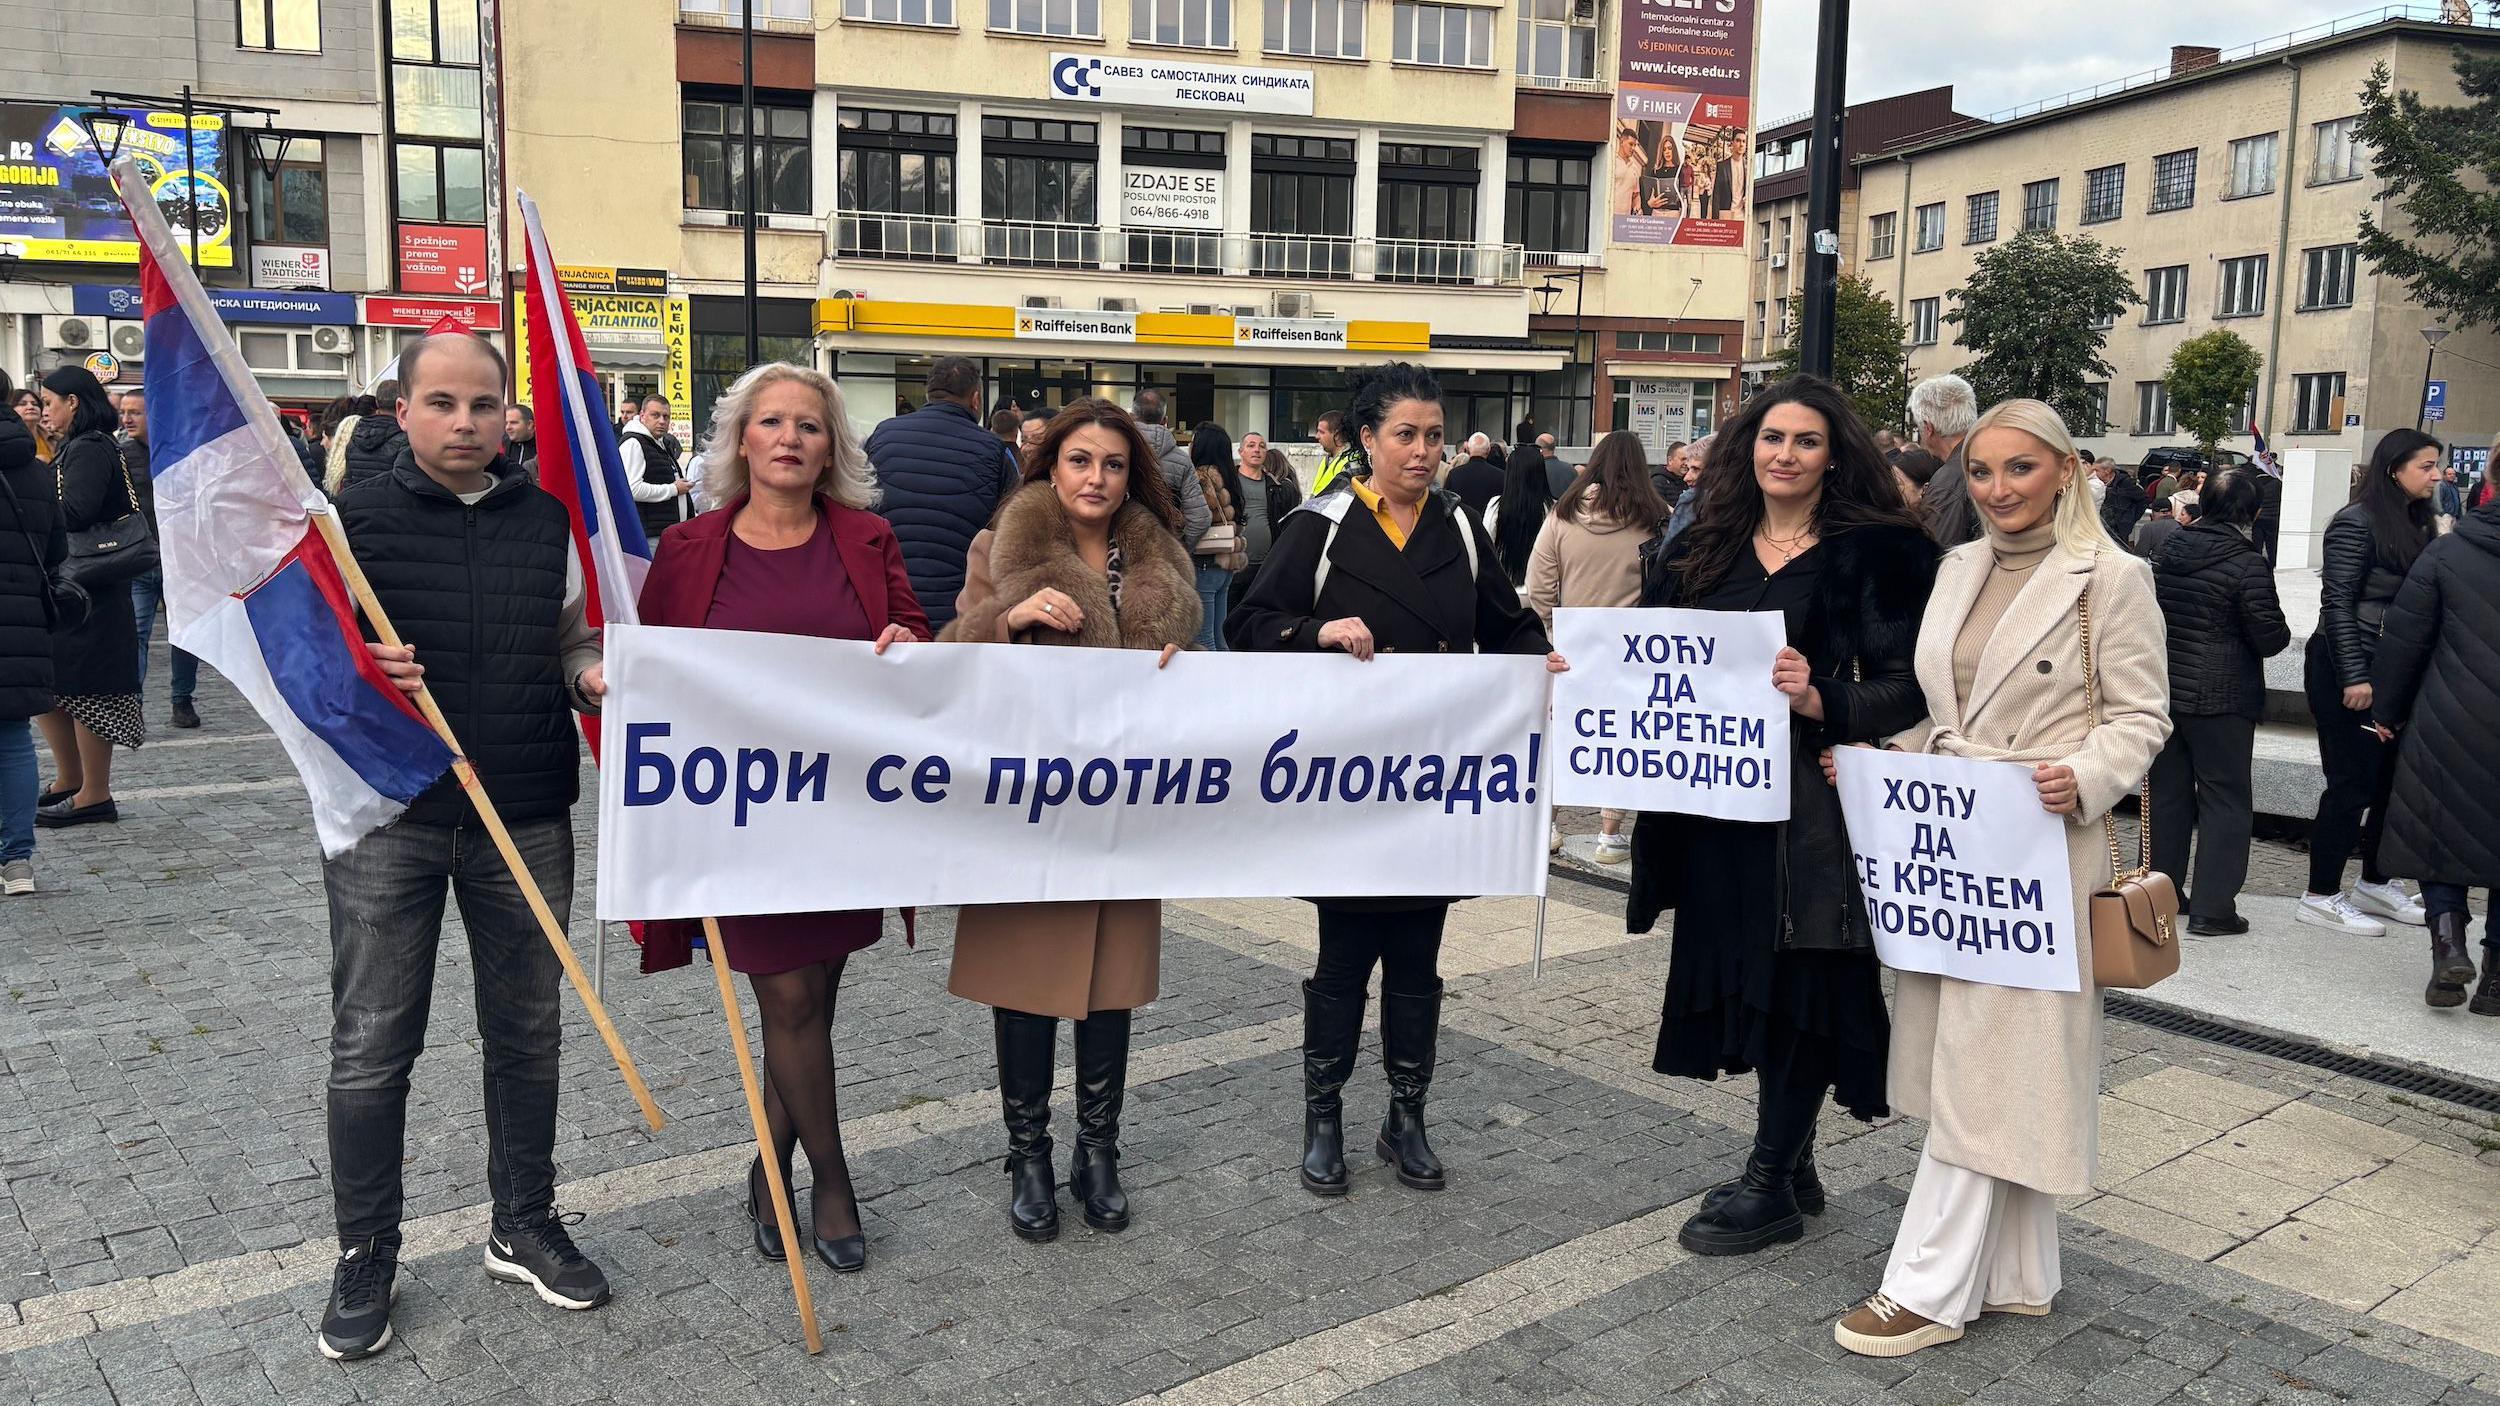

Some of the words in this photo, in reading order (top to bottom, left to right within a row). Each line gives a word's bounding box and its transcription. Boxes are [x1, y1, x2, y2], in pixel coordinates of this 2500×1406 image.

[1641, 11, 1699, 24] Internacionalni
[1700, 17, 1724, 26] centar
[1648, 25, 1701, 36] profesionalne
[1702, 29, 1728, 40] studije
[1638, 39, 1648, 50] VŠ
[1649, 42, 1689, 53] JEDINICA
[1691, 45, 1735, 57] LESKOVAC
[1630, 60, 1740, 79] www.iceps.edu.rs
[1104, 65, 1143, 78] САВЕЗ
[1151, 69, 1237, 85] САМОСТАЛНИХ
[1242, 75, 1310, 90] СИНДИКАТА
[1176, 88, 1245, 104] ЛЕСКОВАЦ
[1643, 100, 1682, 115] FIMEK
[10, 141, 33, 161] A2
[1125, 173, 1188, 191] IZDAJE
[1194, 177, 1216, 192] SE
[15, 200, 44, 209] obuka
[1123, 191, 1170, 203] POSLOVNI
[1173, 194, 1217, 205] PROSTOR
[30, 215, 57, 224] vozila
[1130, 205, 1209, 220] 064/866-4918
[405, 235, 411, 244] S
[413, 236, 458, 248] pažnjom
[405, 250, 439, 260] prema
[261, 259, 301, 269] WIENER
[406, 262, 447, 272] važnom
[559, 270, 610, 280] ENJAČNICA
[588, 283, 611, 291] OFFICE
[243, 299, 321, 312] ШТЕДИОНИЦА
[392, 307, 421, 316] WIENER
[569, 296, 657, 314] ENjAČNICA
[589, 315, 659, 328] ATLANTIKO
[1034, 320, 1098, 333] Raiffeisen
[1100, 323, 1132, 335] Bank
[1252, 328, 1312, 341] Raiffeisen
[1314, 330, 1343, 342] Bank
[1636, 384, 1656, 394] IMS
[2427, 385, 2440, 402] P
[1625, 635, 1715, 665] ХОЋУ
[1648, 673, 1697, 709] ДА
[1574, 708, 1617, 738] СЕ
[1632, 710, 1765, 749] КРЕЋЕМ
[623, 722, 830, 827] Бори
[867, 754, 951, 804] се
[985, 757, 1232, 824] против
[1259, 728, 1542, 816] блокада!
[1569, 745, 1771, 790] СЛОБОДНО!
[1884, 778, 1976, 821] ХОЋУ
[1911, 823, 1957, 862] ДА
[1894, 861, 2043, 911] КРЕЋЕМ
[1868, 896, 2056, 956] ЛОБОДНО!
